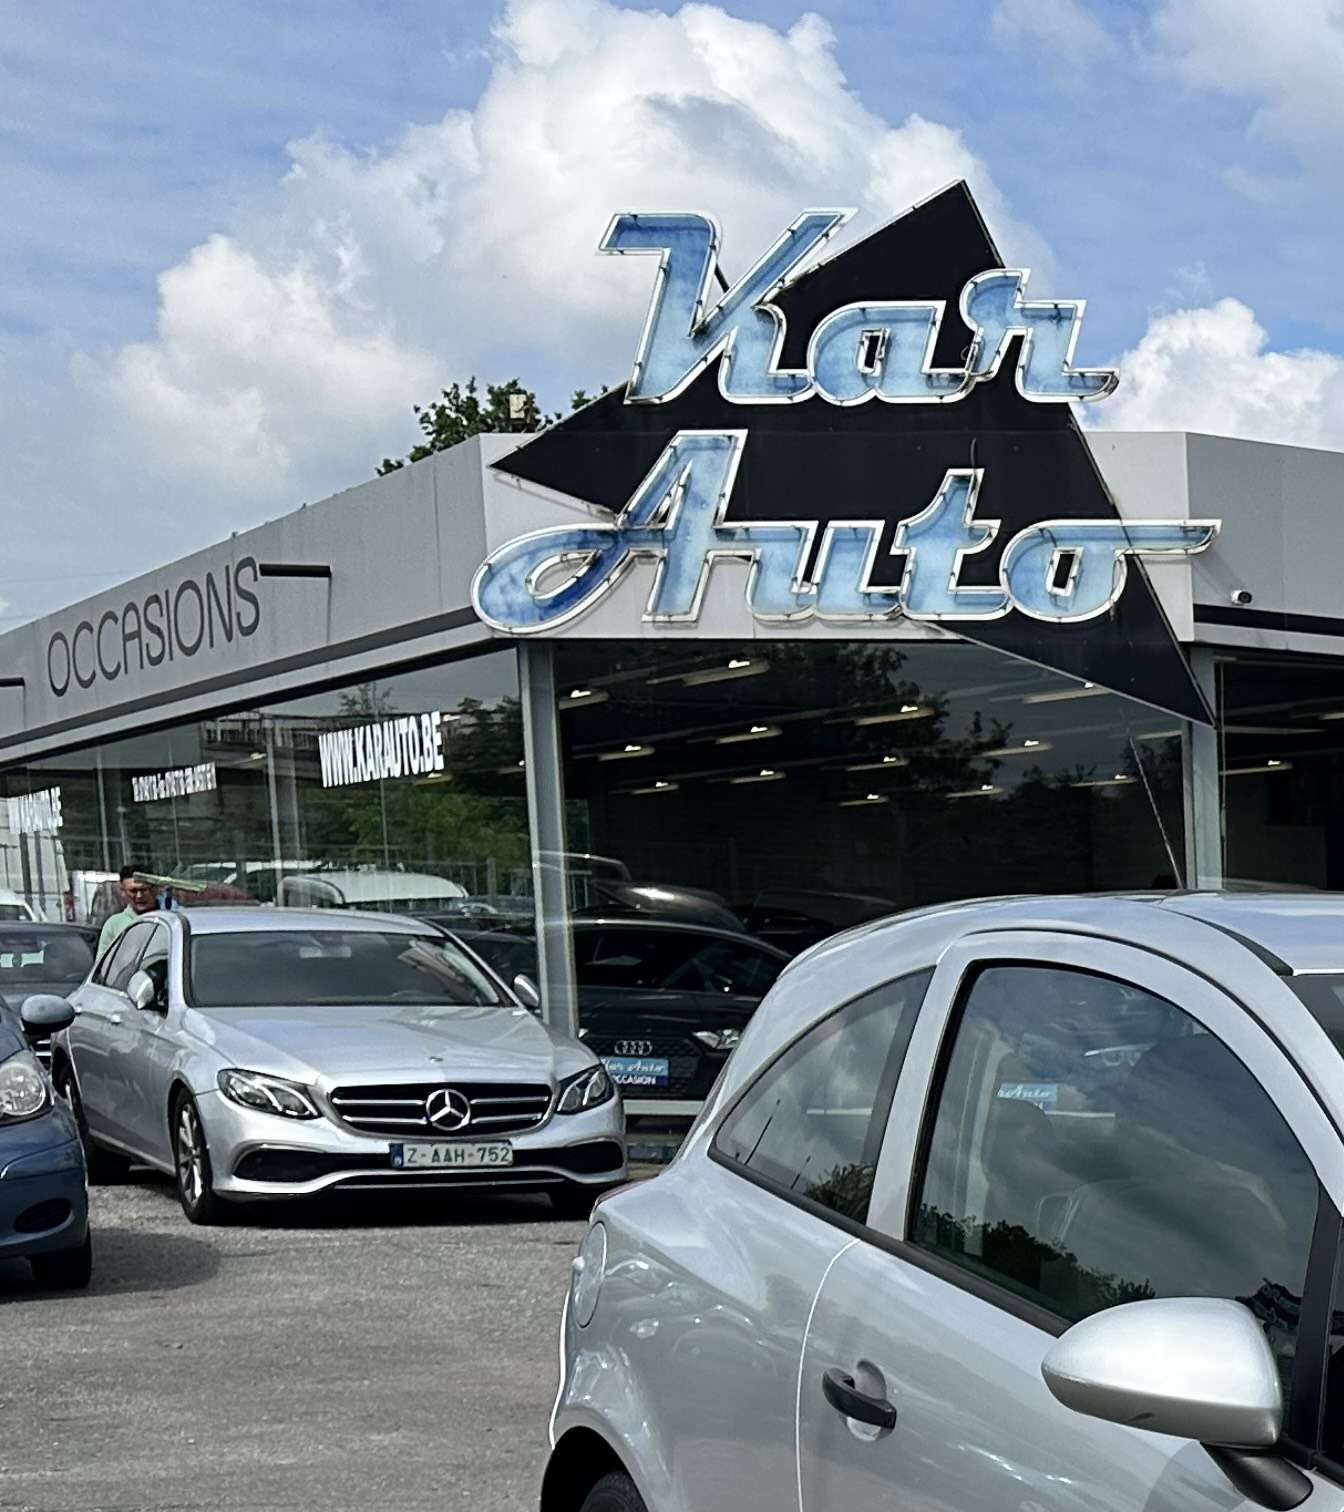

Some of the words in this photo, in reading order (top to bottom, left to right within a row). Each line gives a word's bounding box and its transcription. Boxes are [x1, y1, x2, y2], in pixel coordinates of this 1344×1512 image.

[596, 207, 1121, 405] Kar
[472, 428, 1222, 635] Auto
[47, 556, 260, 697] OCCASIONS
[318, 711, 445, 788] WWW.KARAUTO.BE
[406, 1146, 510, 1164] Z-AAH-752
